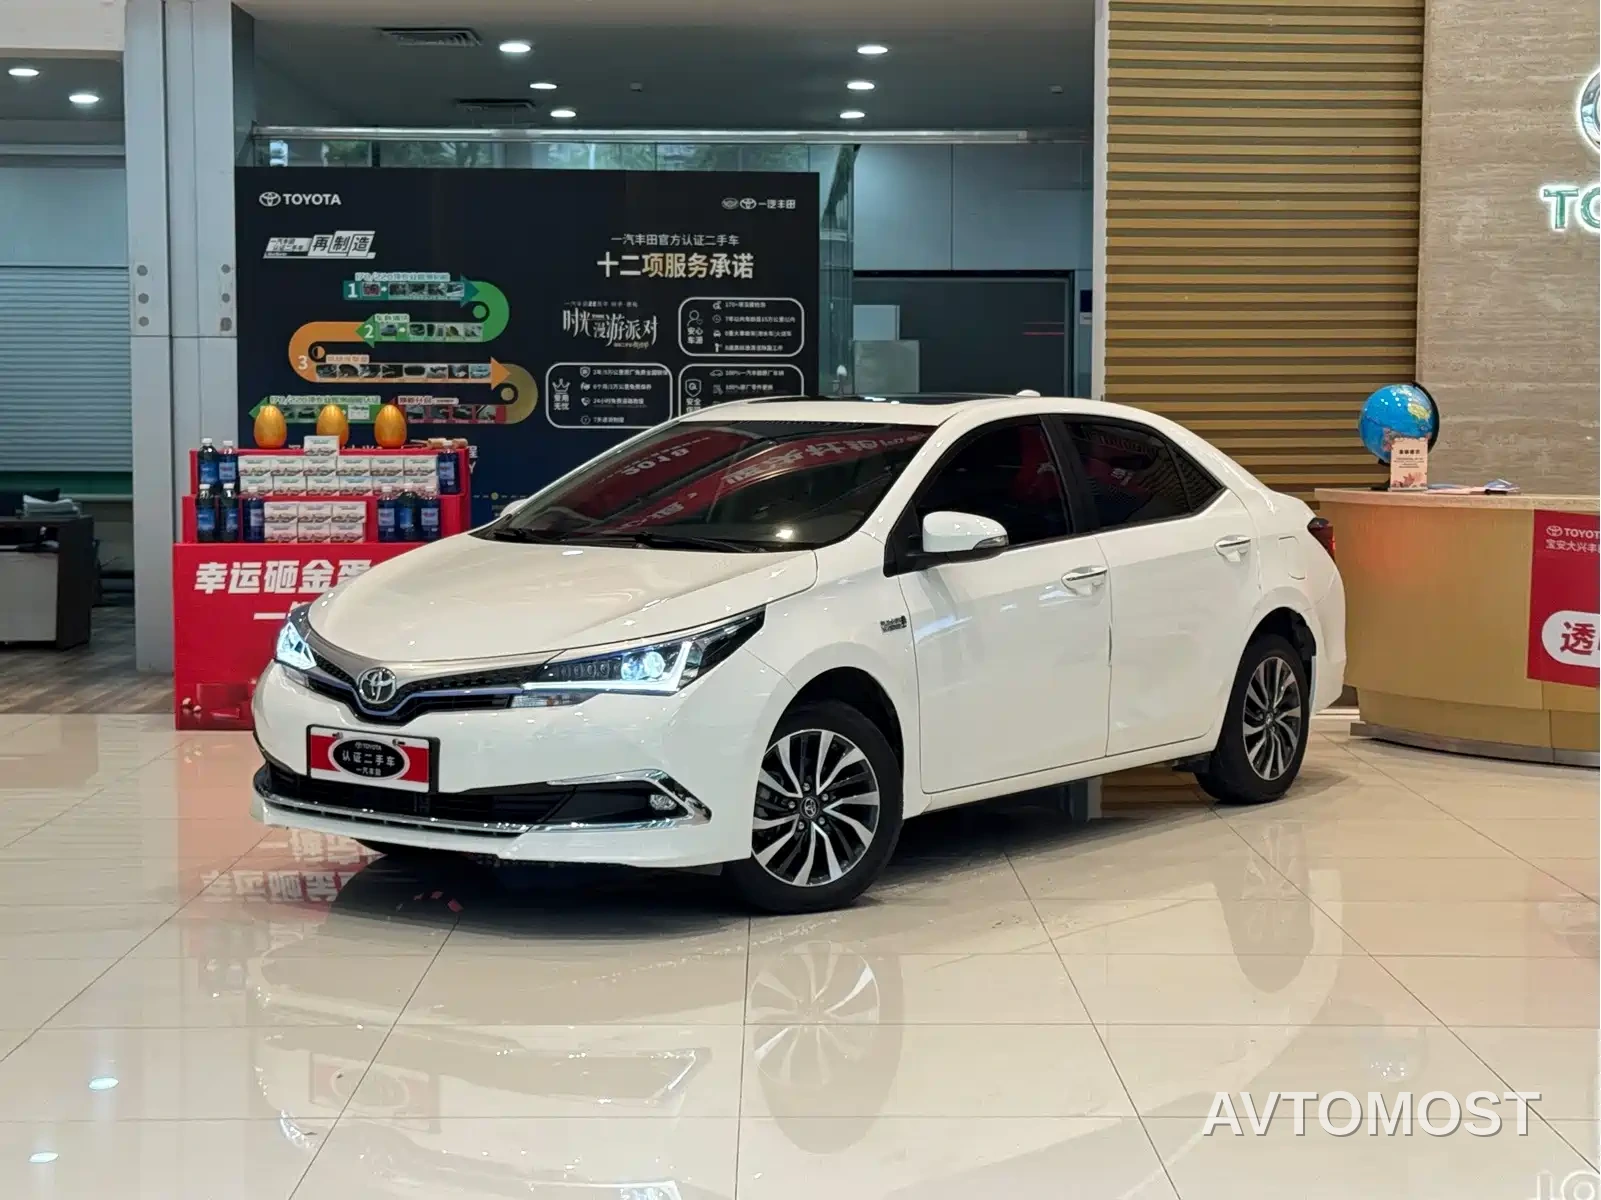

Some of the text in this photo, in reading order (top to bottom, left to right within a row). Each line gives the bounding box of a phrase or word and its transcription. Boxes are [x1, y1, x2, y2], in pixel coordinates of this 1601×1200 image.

[283, 193, 342, 206] TOYOTA
[758, 199, 796, 210] 一汽丰田
[312, 235, 370, 252] 再制造
[611, 233, 740, 247] 一汽丰田官方认证二手车
[597, 251, 754, 279] 十二项服务承诺
[347, 283, 358, 298] 1
[364, 324, 374, 339] 2
[562, 307, 659, 347] 时光漫游派对
[687, 327, 703, 335] 安心
[297, 356, 308, 370] 3
[1560, 621, 1600, 656] 透
[341, 751, 396, 767] 认证二手车
